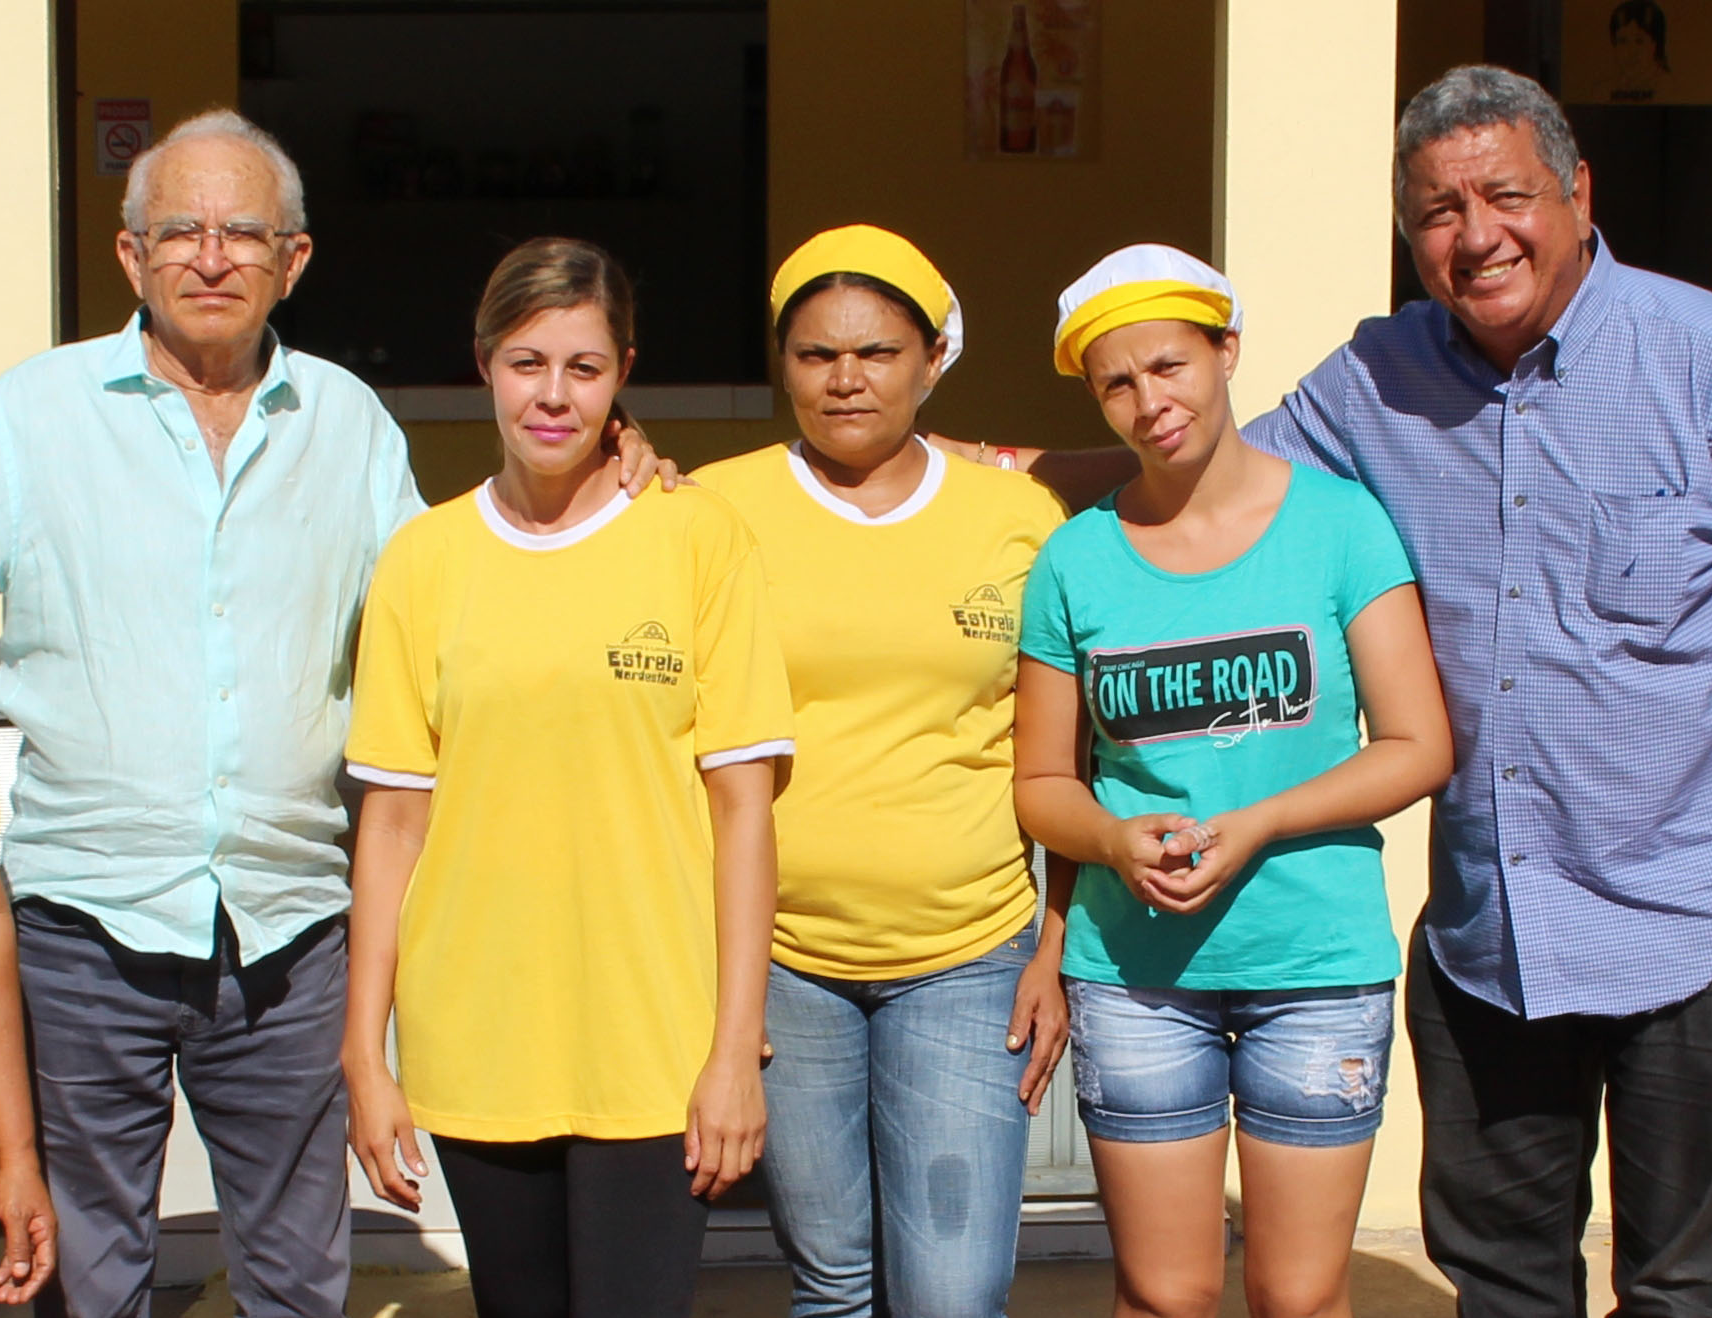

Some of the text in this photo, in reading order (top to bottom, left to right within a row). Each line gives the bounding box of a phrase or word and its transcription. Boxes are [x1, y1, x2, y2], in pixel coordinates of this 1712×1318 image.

[607, 651, 683, 673] Estrela
[1098, 650, 1298, 720] ON THE ROAD
